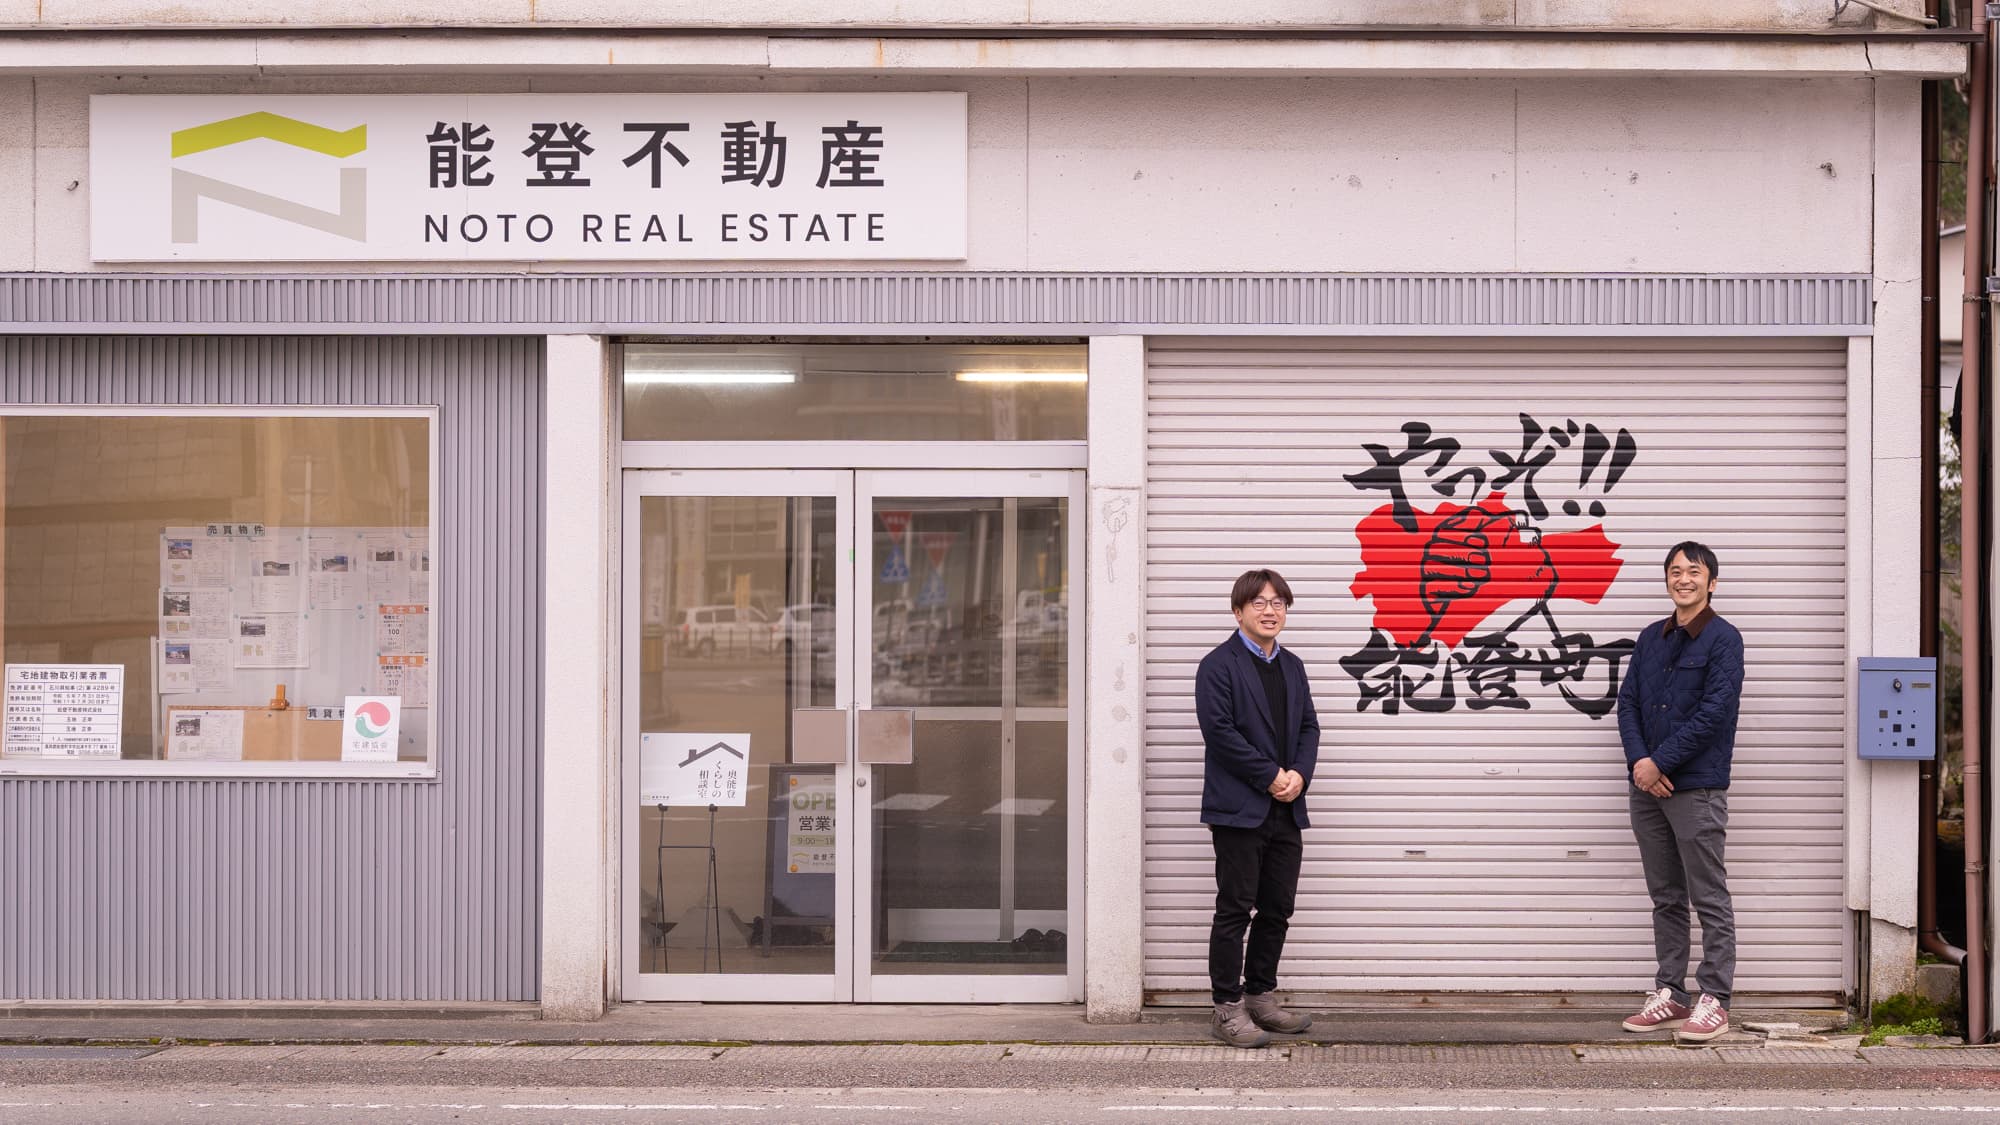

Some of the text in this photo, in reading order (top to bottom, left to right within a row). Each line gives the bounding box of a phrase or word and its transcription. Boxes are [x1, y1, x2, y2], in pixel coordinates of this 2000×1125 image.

[425, 119, 884, 189] 能登不動産
[425, 213, 884, 243] NOTO REAL ESTATE
[208, 525, 263, 535] 売買物件
[20, 671, 107, 680] 宅地建物取引業者票
[1338, 627, 1640, 720] 能登町
[711, 760, 722, 798] くらしの
[792, 792, 836, 810] OPE
